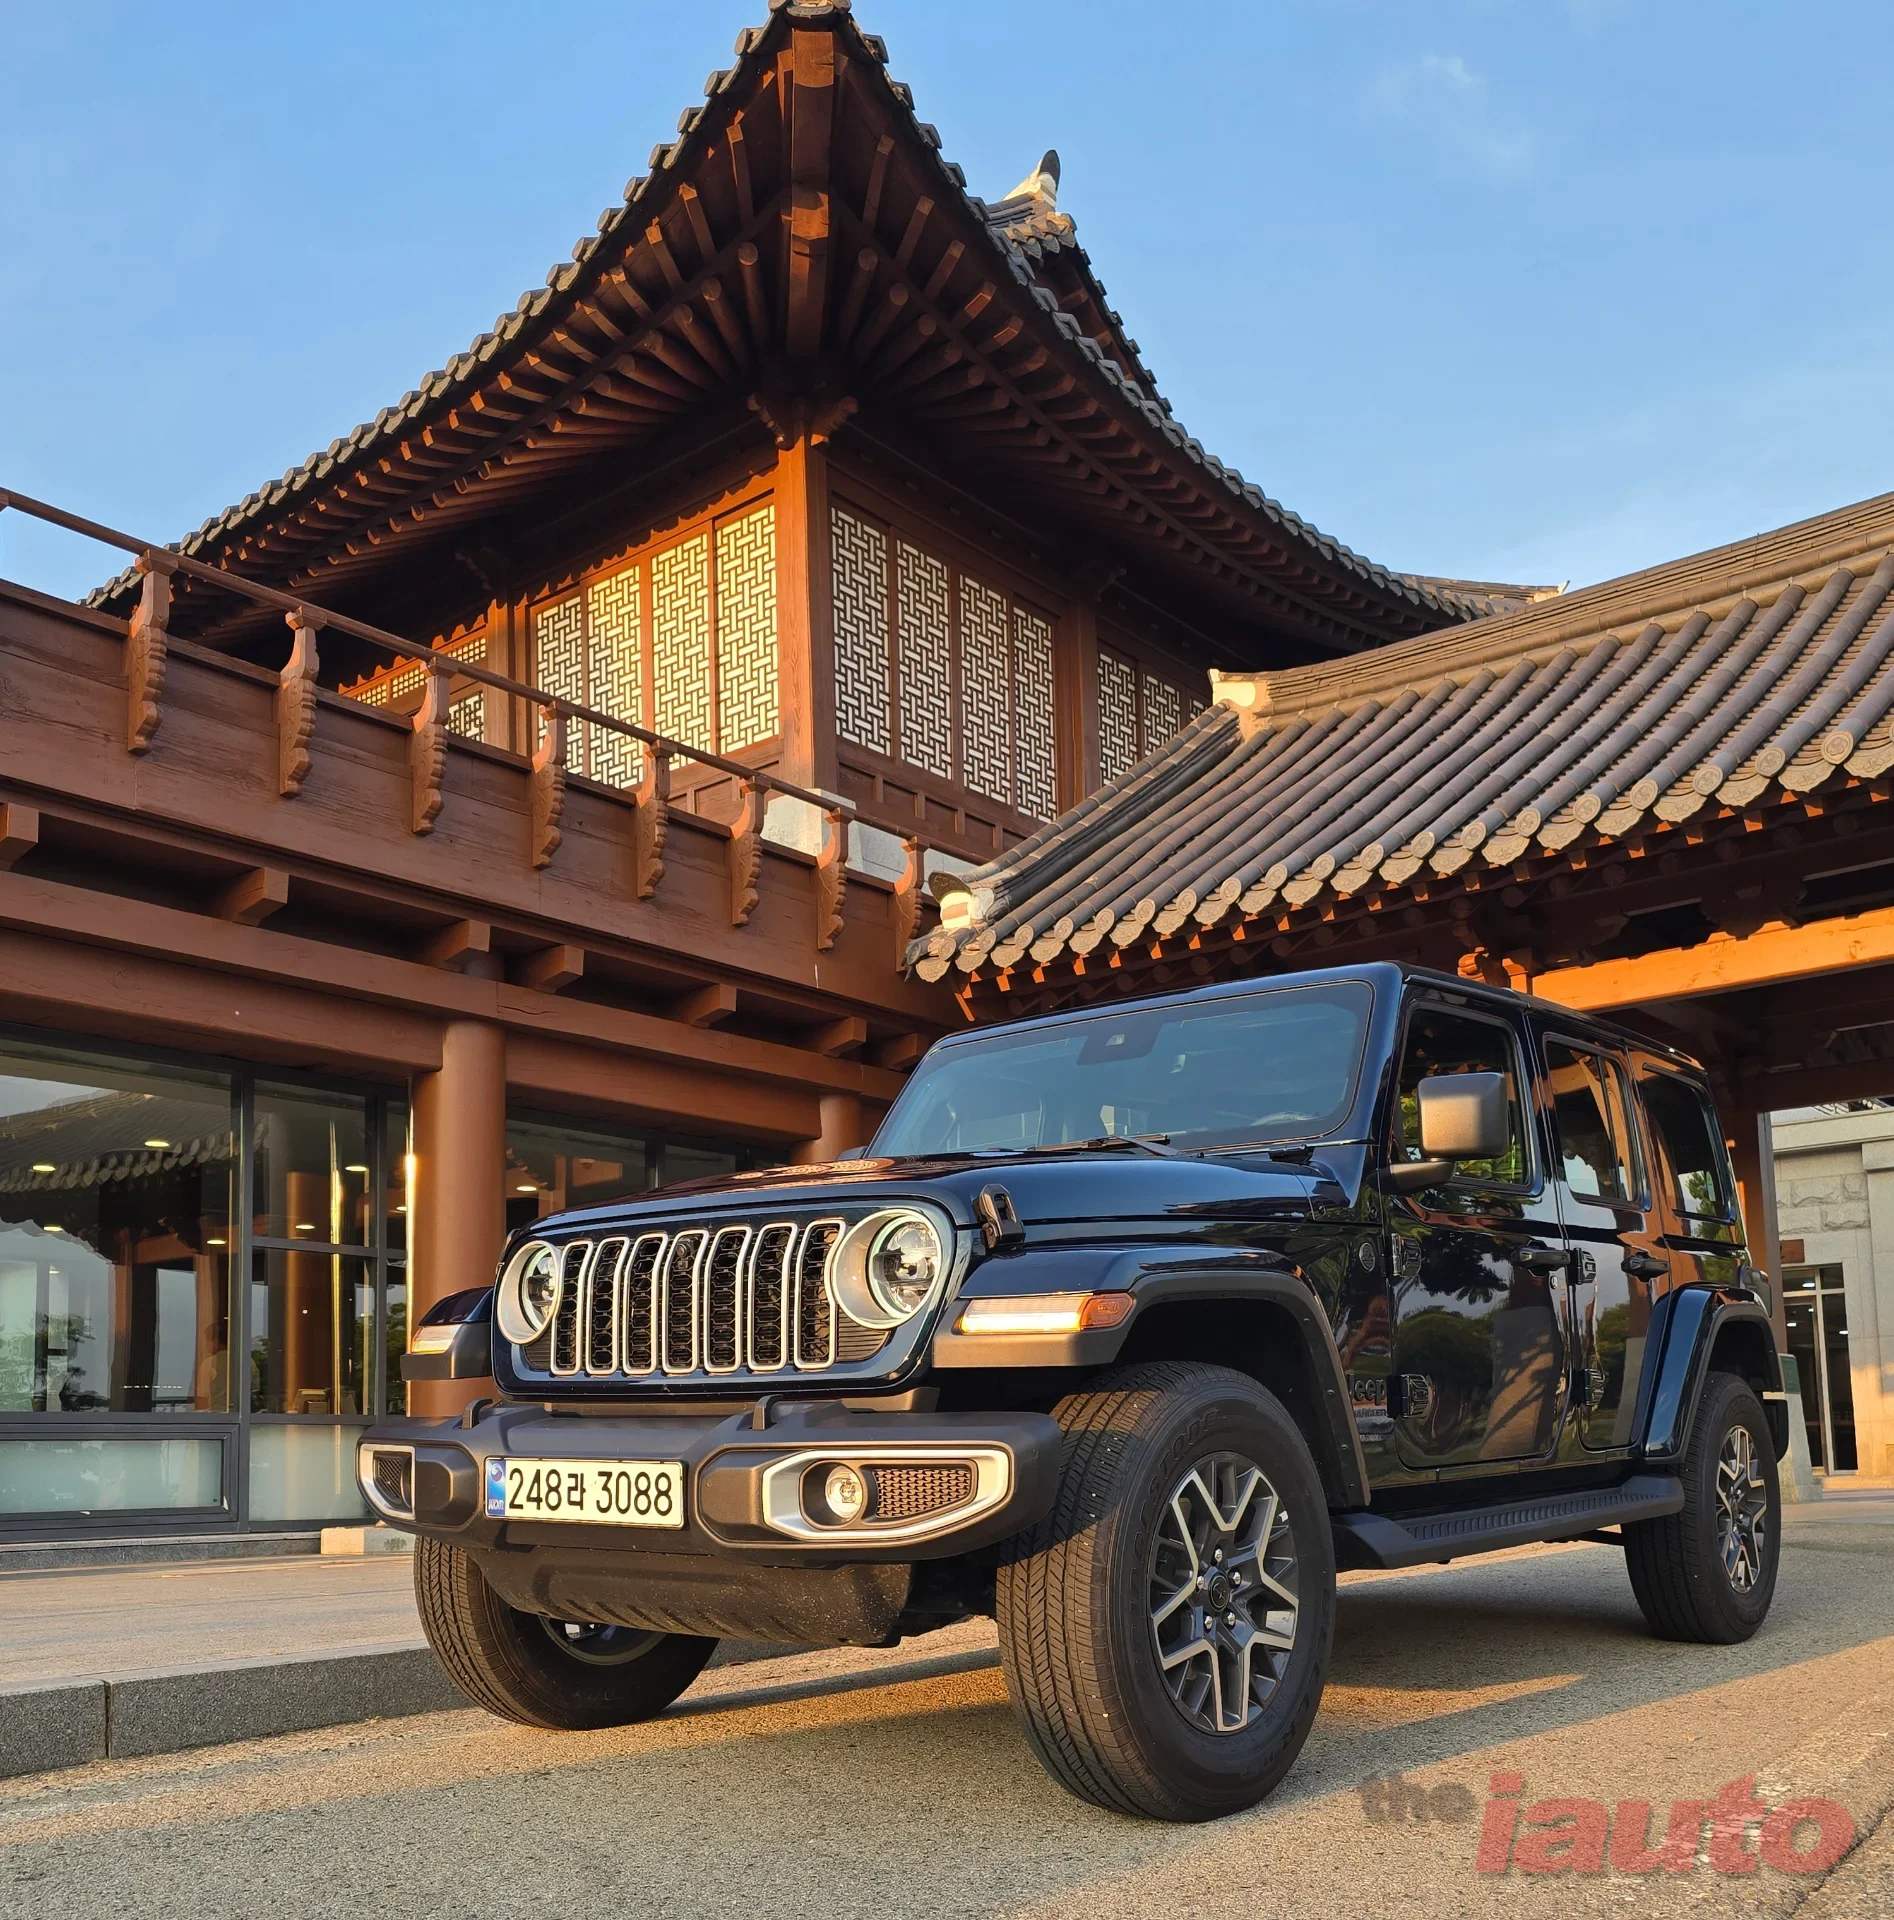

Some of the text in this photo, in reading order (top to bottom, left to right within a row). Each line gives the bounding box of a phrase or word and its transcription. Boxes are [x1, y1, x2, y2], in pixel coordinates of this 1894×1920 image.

[1348, 1373, 1387, 1406] Jeep
[508, 1467, 673, 1516] 248라 3088
